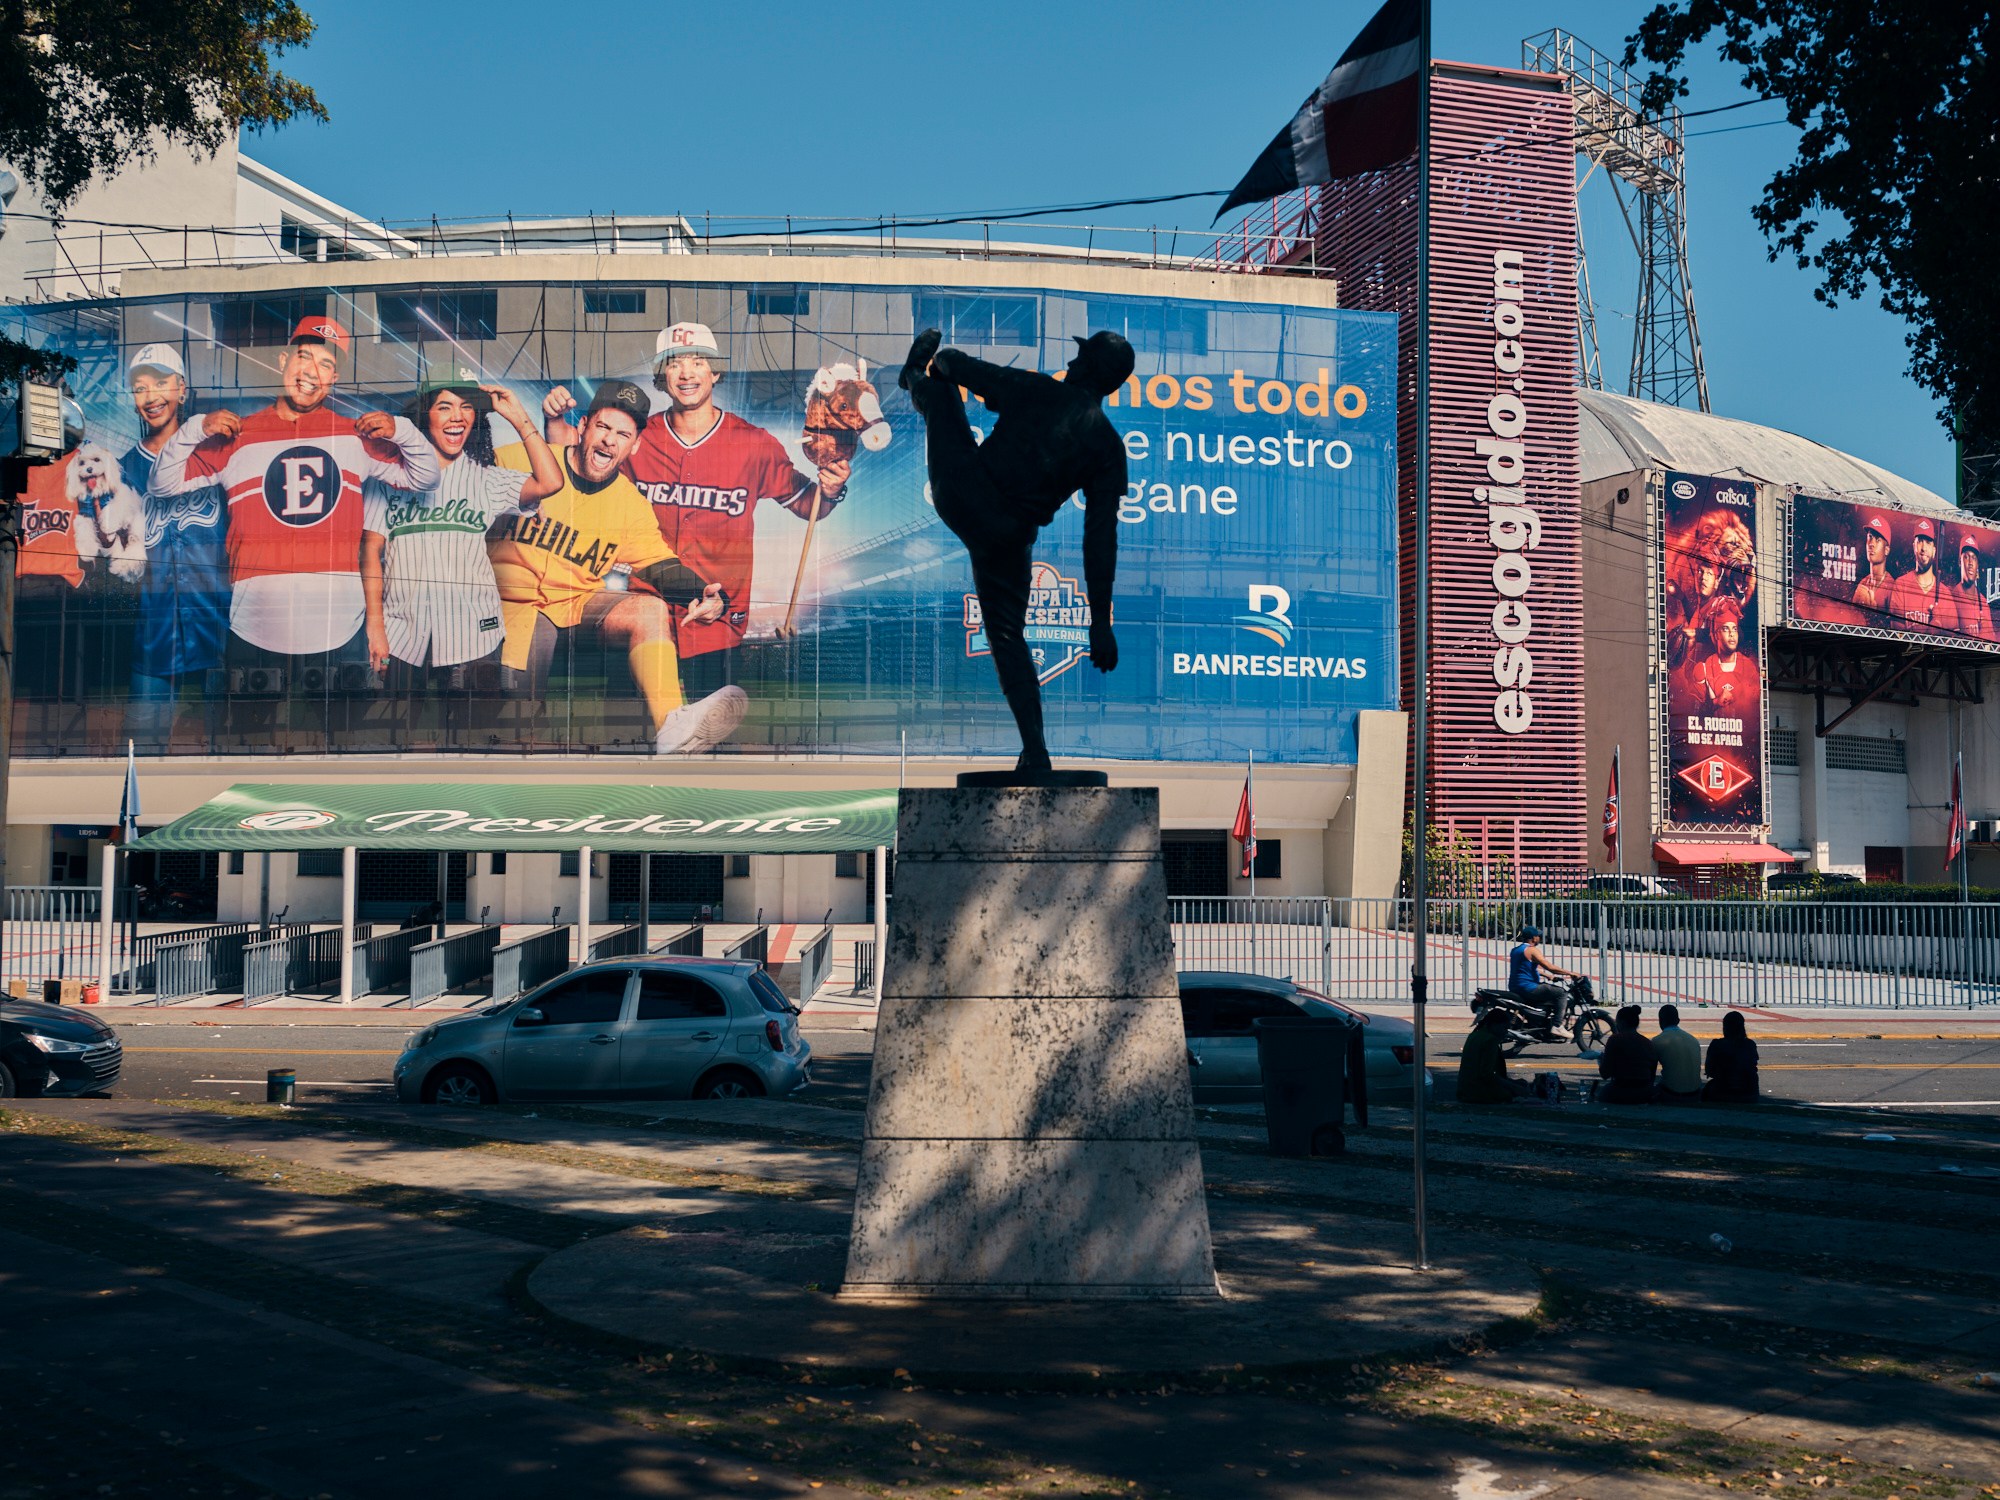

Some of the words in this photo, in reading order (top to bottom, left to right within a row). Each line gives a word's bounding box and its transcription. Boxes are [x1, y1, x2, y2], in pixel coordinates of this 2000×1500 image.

[1229, 368, 1368, 418] todo
[1167, 430, 1353, 469] nuestro
[280, 456, 324, 516] E
[1474, 249, 1541, 734] escogido.com
[1716, 490, 1750, 506] CRISOL
[1117, 479, 1238, 523] gane
[386, 495, 487, 534] Estrellas
[501, 513, 618, 577] AGUILAS
[1822, 543, 1842, 559] POR
[1843, 545, 1857, 561] LA
[1822, 560, 1857, 582] XVIII
[1028, 589, 1061, 607] OPA
[1036, 628, 1088, 642] INVERNAL
[1173, 653, 1367, 679] BANRESERVAS
[1688, 716, 1702, 731] EL
[1688, 732, 1700, 744] NO
[1701, 733, 1713, 745] SE
[1714, 734, 1743, 746] APAGA
[1708, 761, 1725, 789] E
[365, 809, 842, 833] Presidente
